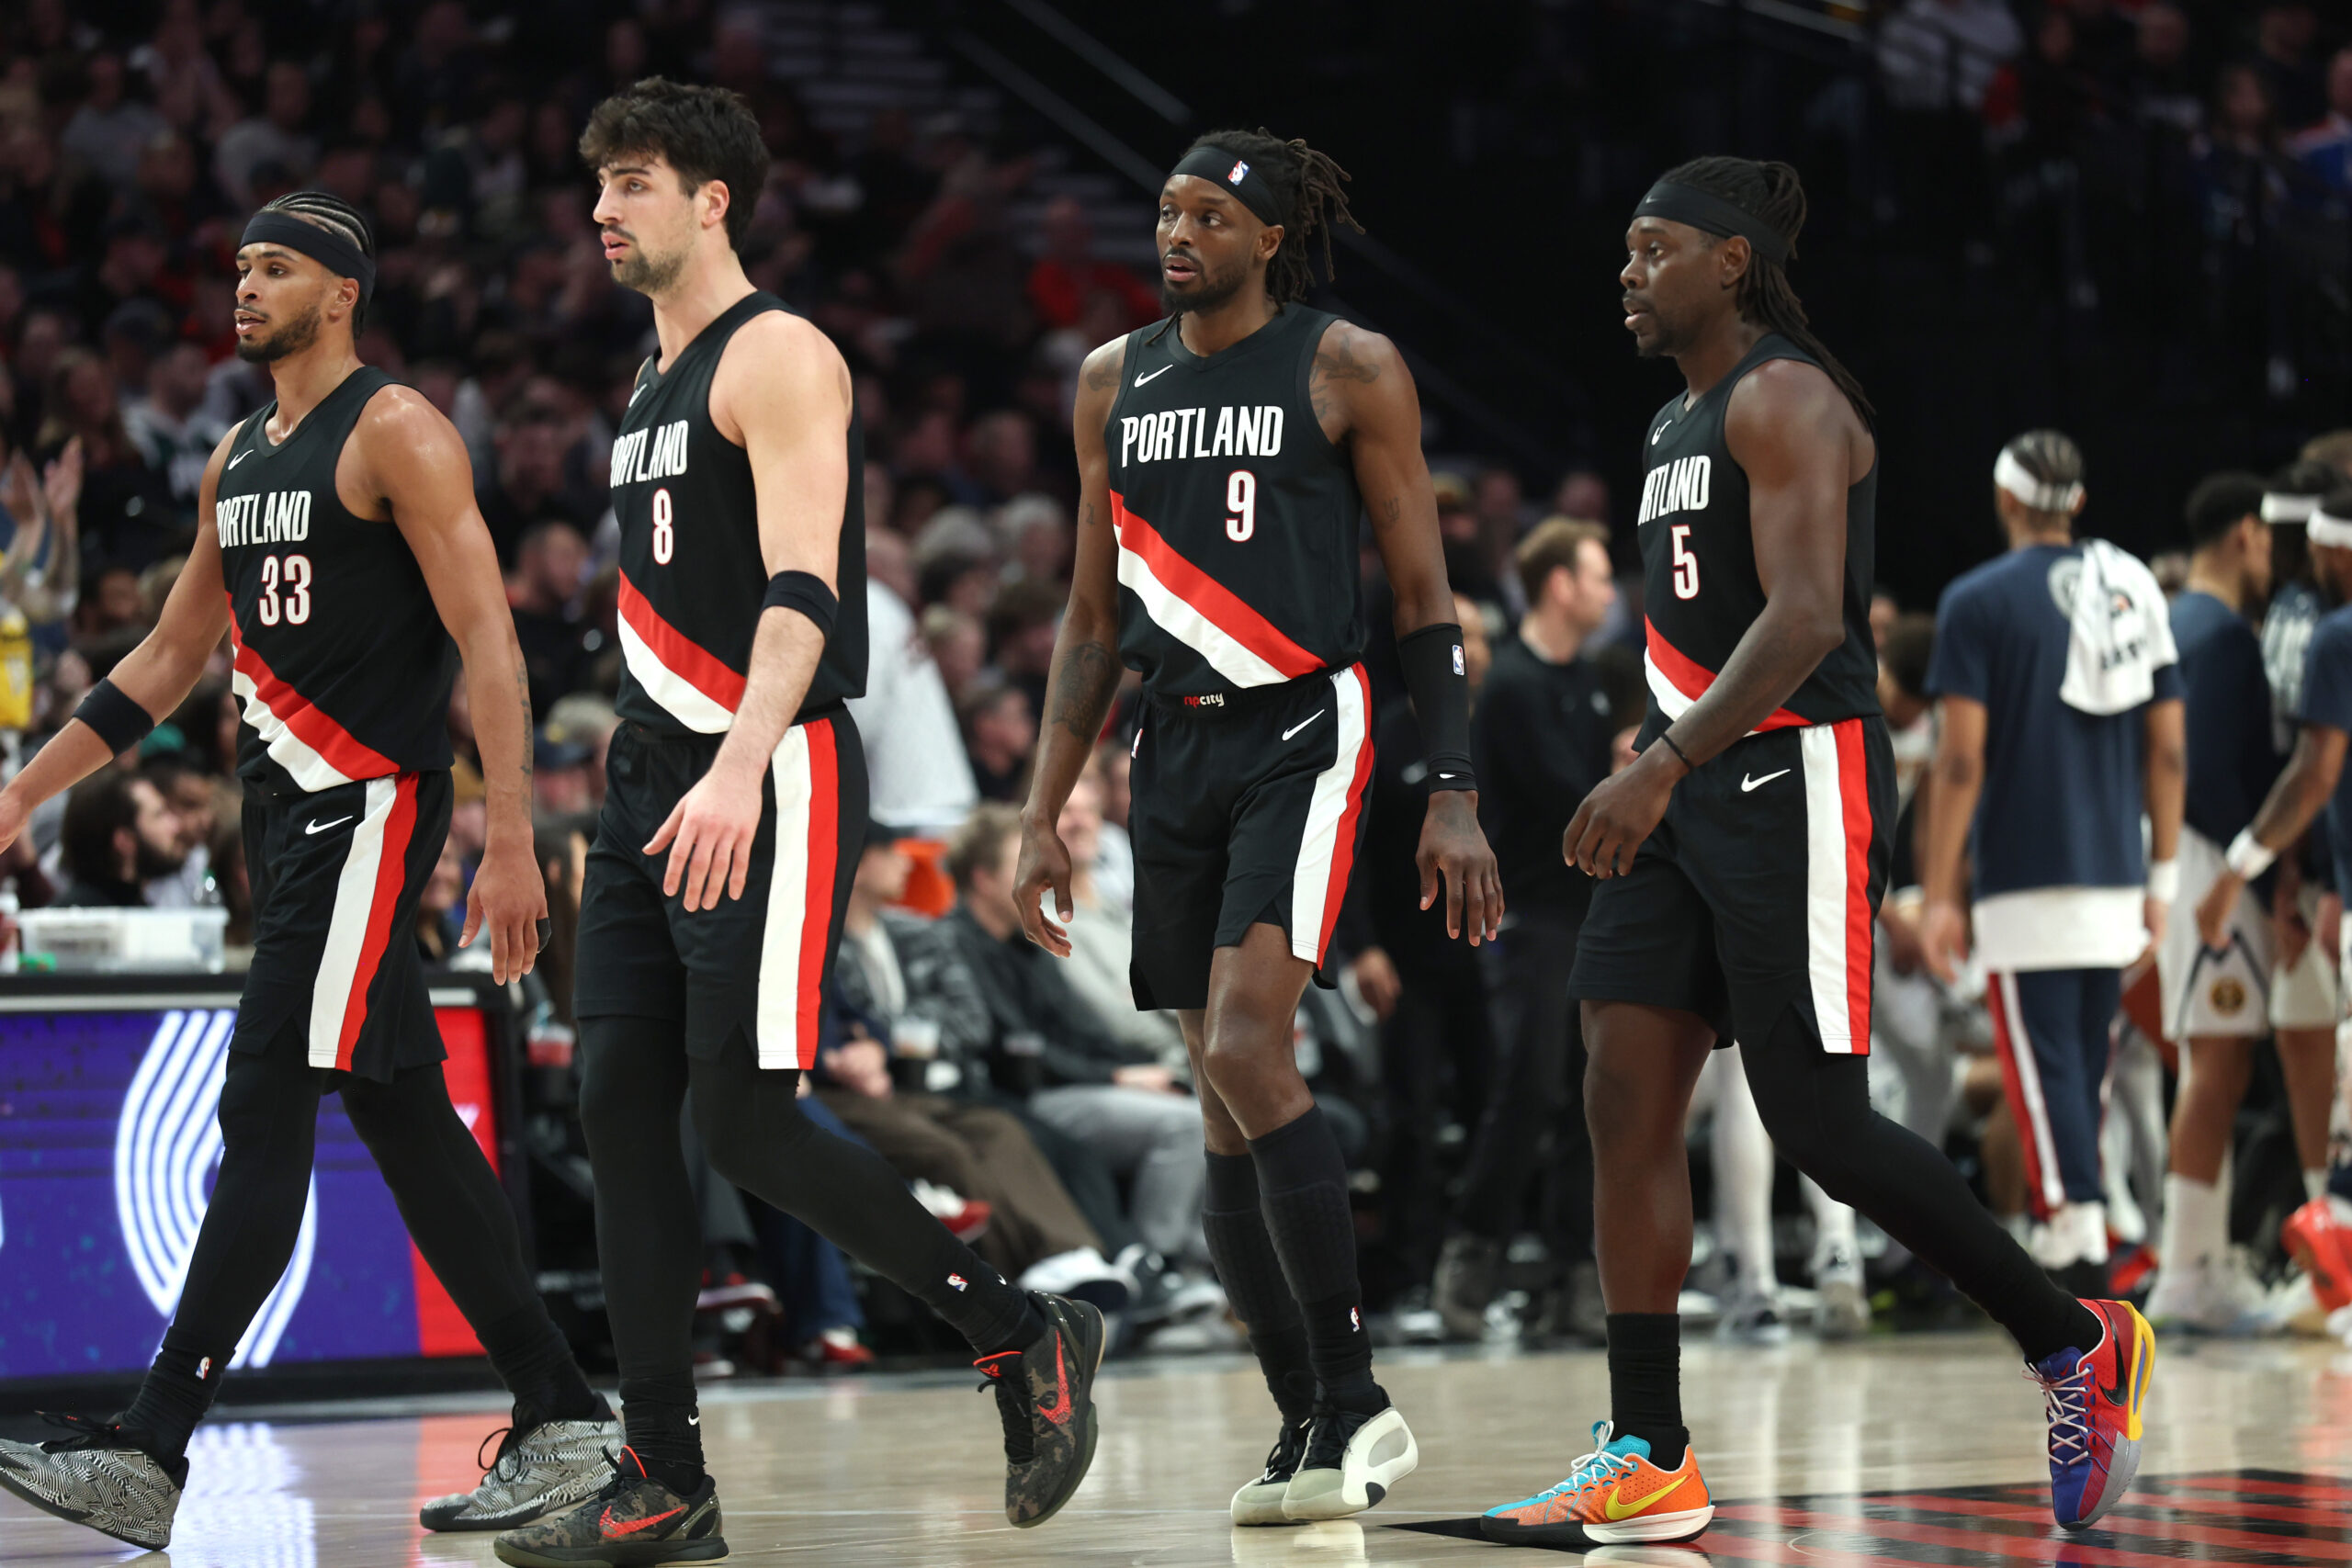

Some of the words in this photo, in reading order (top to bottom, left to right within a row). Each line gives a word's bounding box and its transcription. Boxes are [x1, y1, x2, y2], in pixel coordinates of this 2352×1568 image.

[610, 420, 689, 489] ORTLAND
[1120, 405, 1284, 468] PORTLAND
[652, 487, 673, 566] 8
[1225, 468, 1256, 542] 9
[258, 554, 312, 626] 33
[1670, 524, 1700, 600] 5
